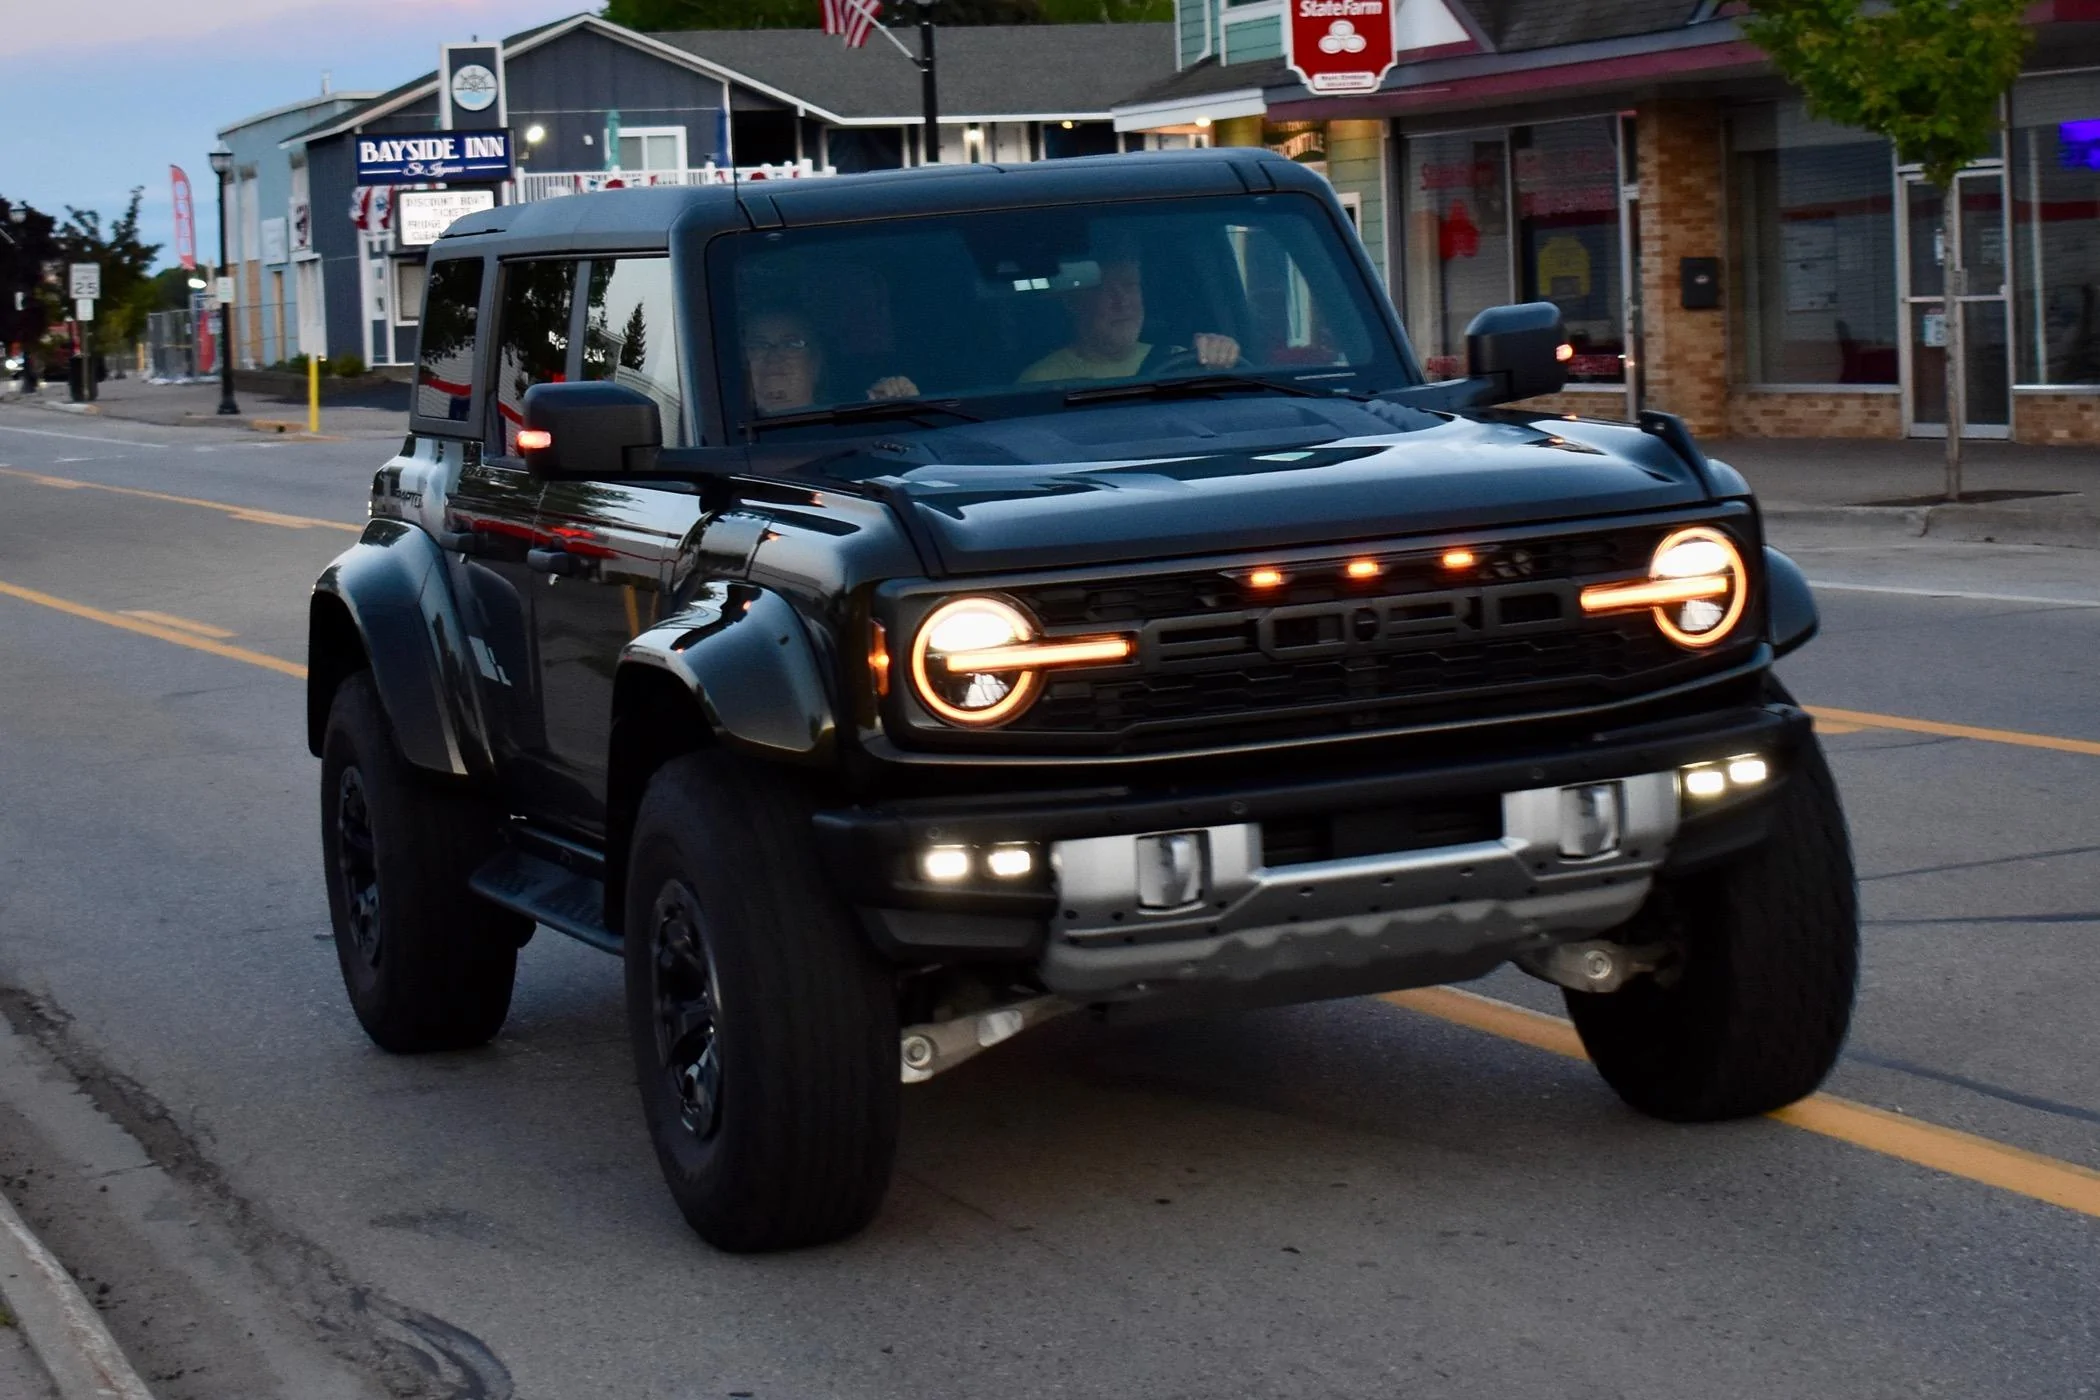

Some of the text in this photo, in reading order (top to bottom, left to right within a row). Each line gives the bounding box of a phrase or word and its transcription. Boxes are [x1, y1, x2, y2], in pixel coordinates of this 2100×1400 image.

[360, 136, 505, 163] BAYSIDE INN
[75, 282, 98, 295] 25
[1143, 578, 1575, 673] FORD
